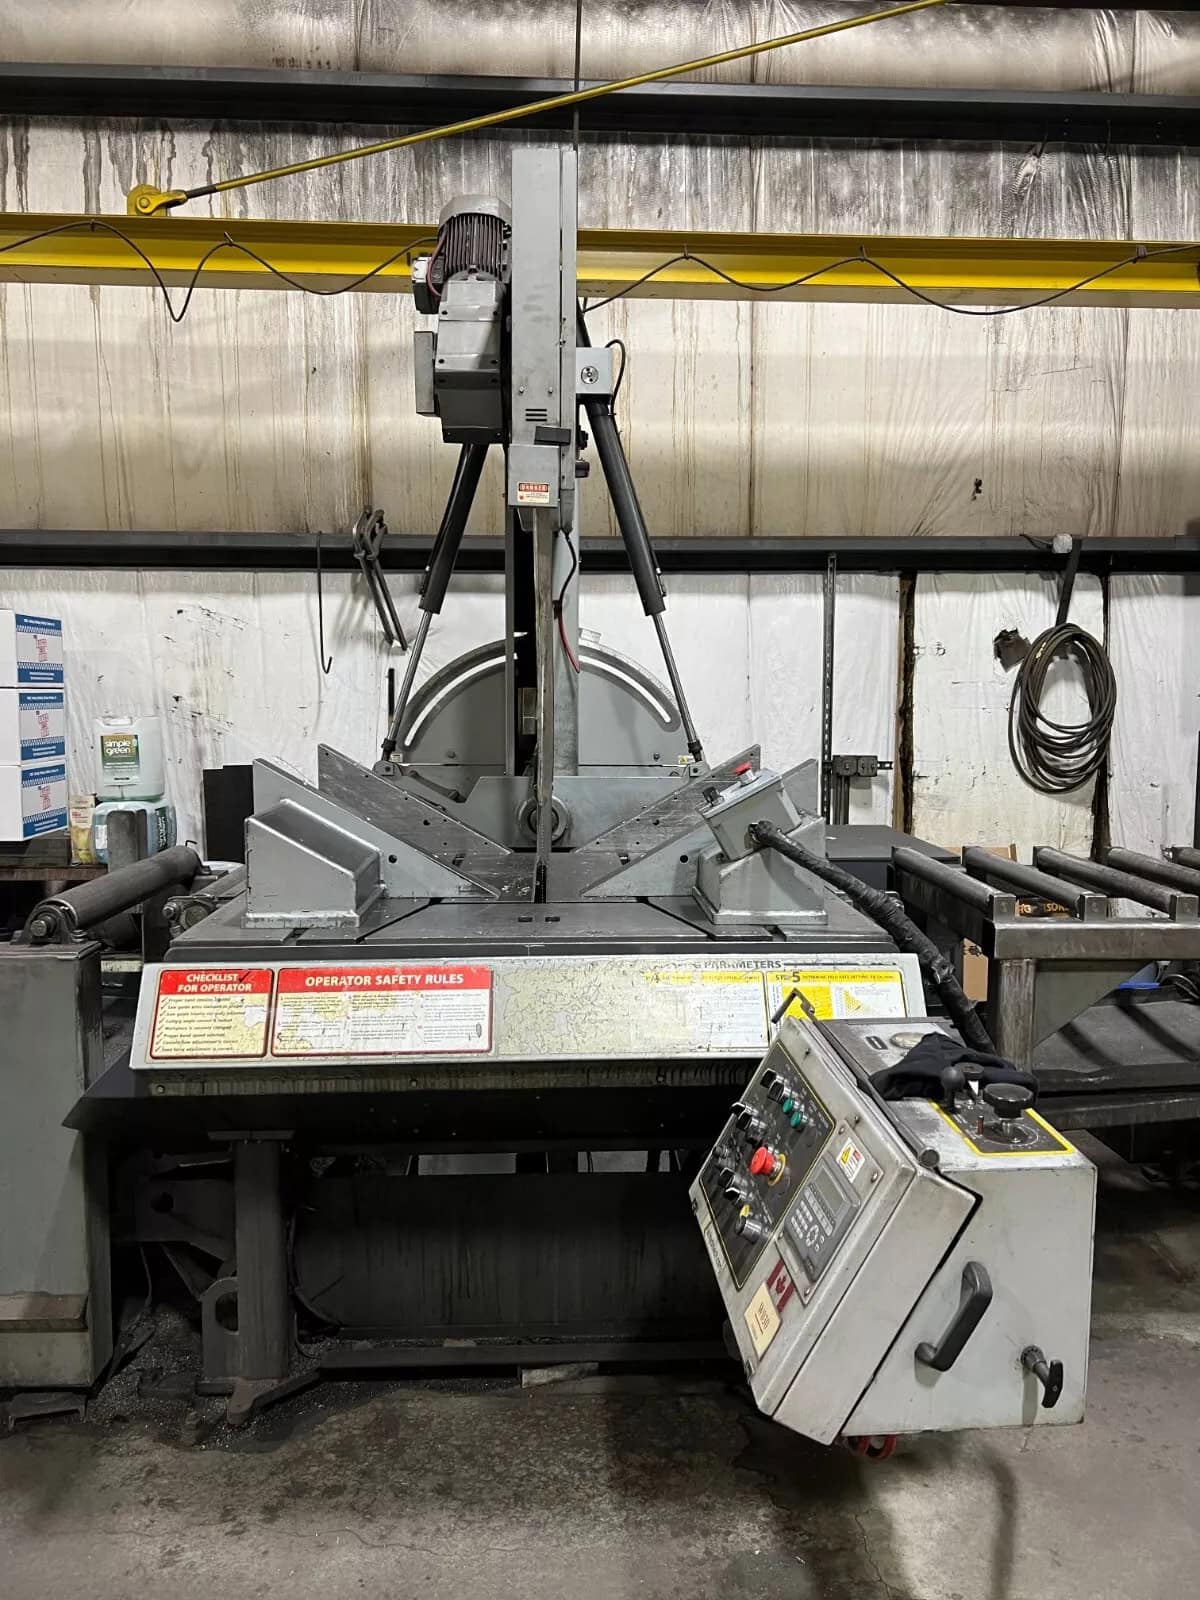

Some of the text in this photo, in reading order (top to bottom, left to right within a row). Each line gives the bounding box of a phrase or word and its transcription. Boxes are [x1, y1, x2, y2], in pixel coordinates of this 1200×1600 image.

[105, 739, 131, 748] simple
[106, 747, 131, 756] green
[186, 973, 239, 982] CHECKLIST
[305, 973, 464, 986] OPERATOR SAFETY RULES
[177, 983, 252, 992] FOR OPERATOR
